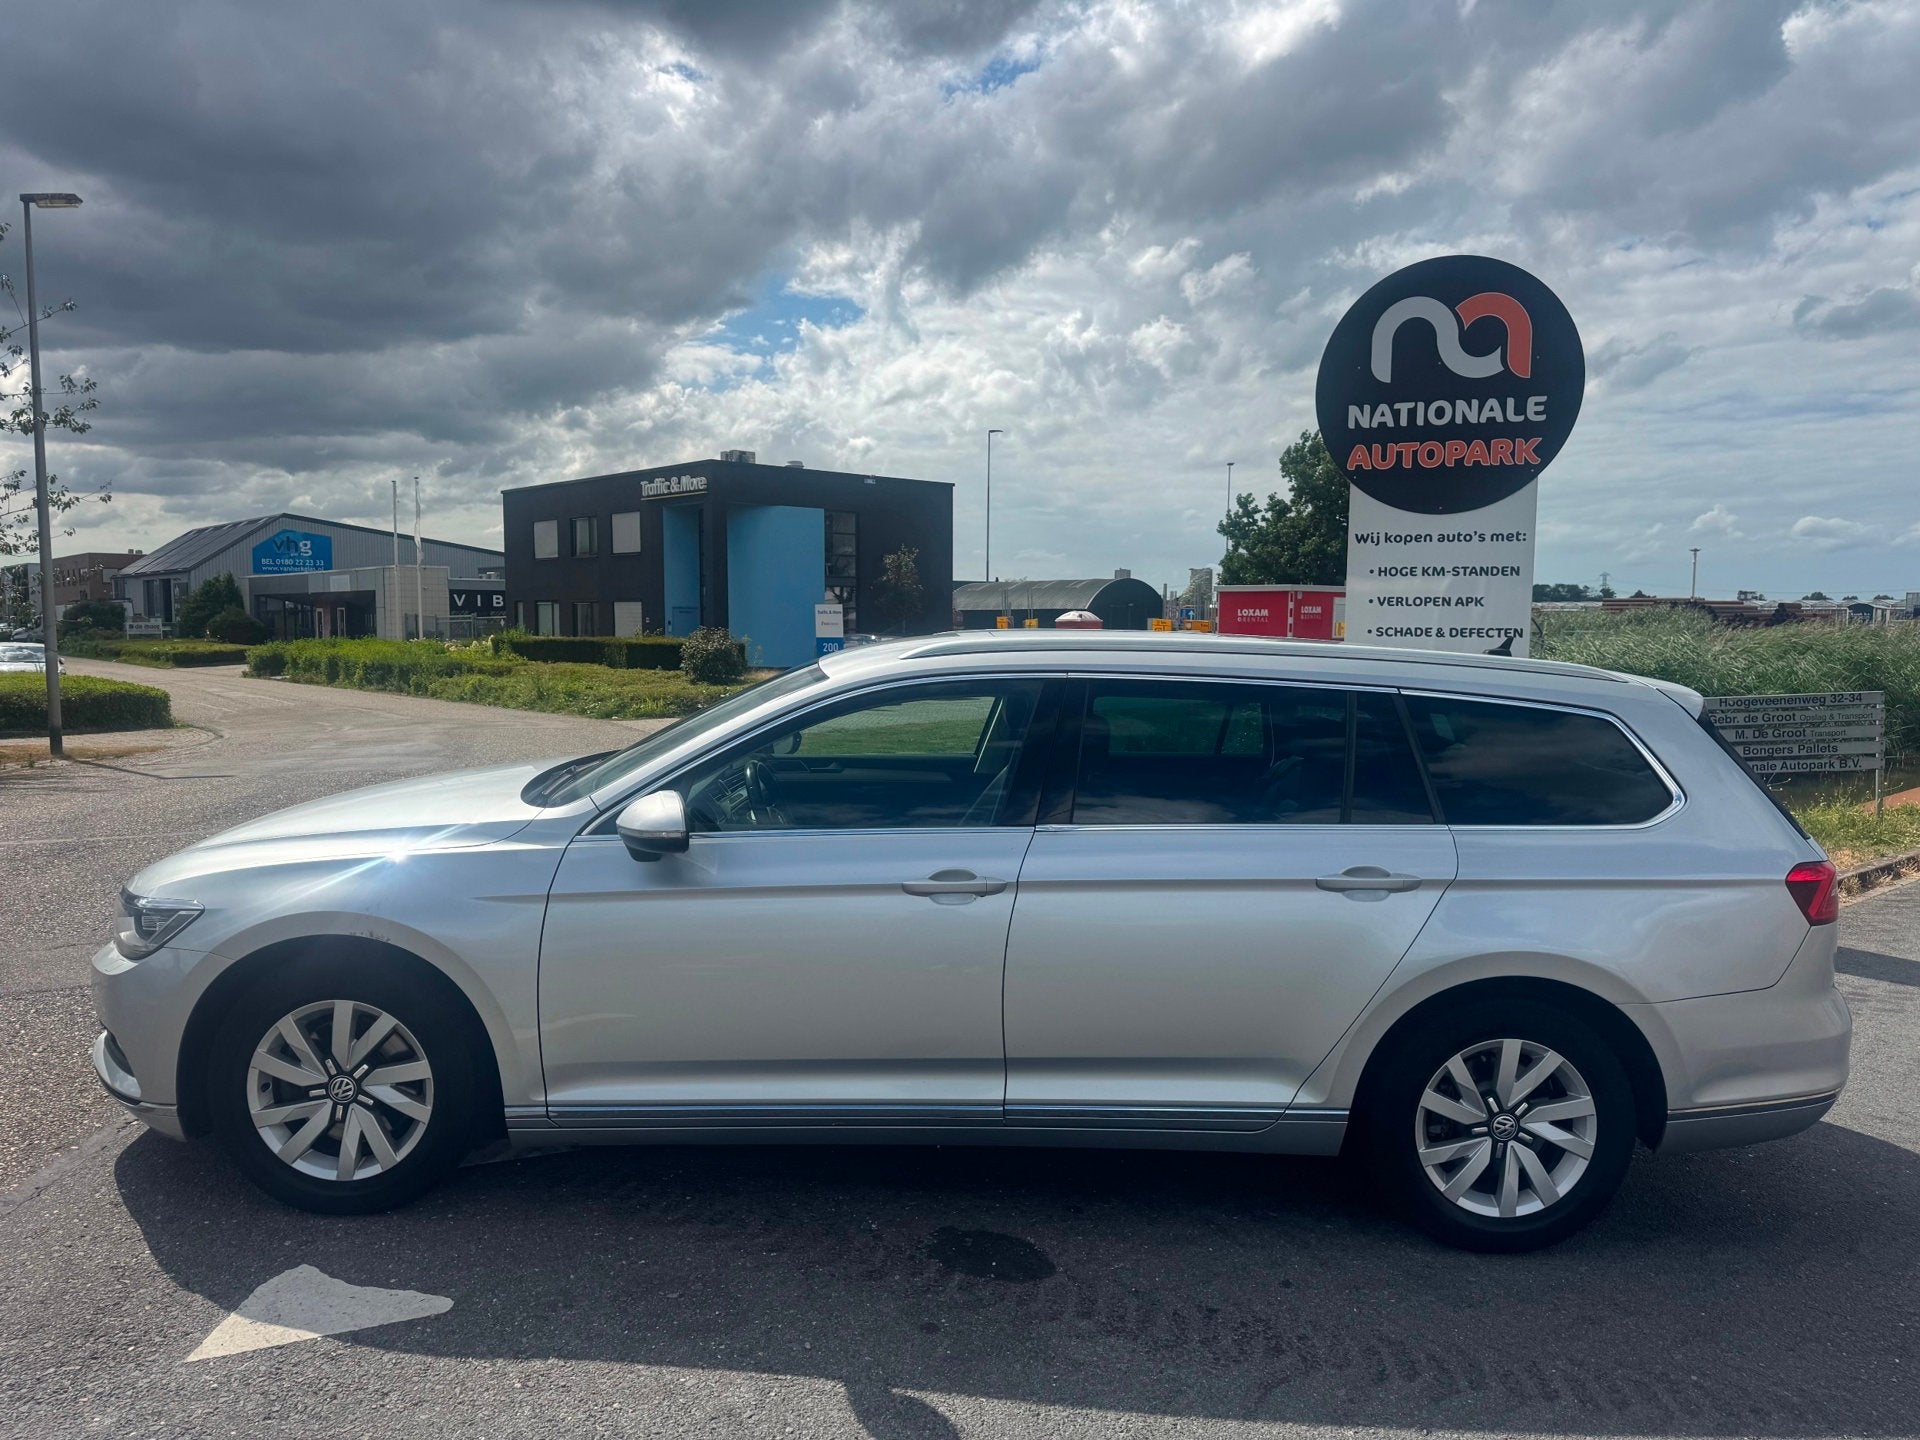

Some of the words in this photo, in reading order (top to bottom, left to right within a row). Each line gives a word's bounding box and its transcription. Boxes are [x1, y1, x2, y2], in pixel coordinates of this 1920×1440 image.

[1347, 395, 1548, 429] NATIONALE
[1346, 437, 1543, 471] AUTOPARK
[640, 477, 670, 497] Traffic
[670, 476, 680, 493] &
[680, 474, 708, 491] More
[1354, 532, 1380, 546] Wij
[1384, 532, 1433, 546] kopen
[1436, 530, 1486, 543] auto's
[1490, 530, 1527, 543] met:
[272, 535, 313, 557] vhg
[1377, 566, 1418, 577] HOGE
[1421, 566, 1521, 577] KM-STANDEN
[1376, 596, 1451, 607] VERLOPEN
[1454, 596, 1485, 607] APK
[1237, 608, 1269, 617] LOXAM
[1301, 605, 1322, 614] LOXAM
[1375, 627, 1433, 638] SCHADE
[1435, 627, 1446, 638] &
[1449, 627, 1524, 639] DEFECTEN
[822, 642, 839, 652] 200
[1719, 696, 1826, 709] Hoogeveenenweg
[1830, 693, 1863, 703] 32-34
[1744, 714, 1759, 723] de
[1762, 712, 1796, 722] Groot
[1838, 712, 1873, 720] Transport
[1735, 729, 1749, 740] M.
[1753, 729, 1769, 739] De
[1772, 728, 1807, 738] Groot
[1810, 729, 1847, 737] Transport
[1743, 745, 1794, 757] Bongers
[1798, 744, 1839, 754] Pallets
[1780, 759, 1836, 772] Autopark
[1839, 758, 1862, 769] B.V.
